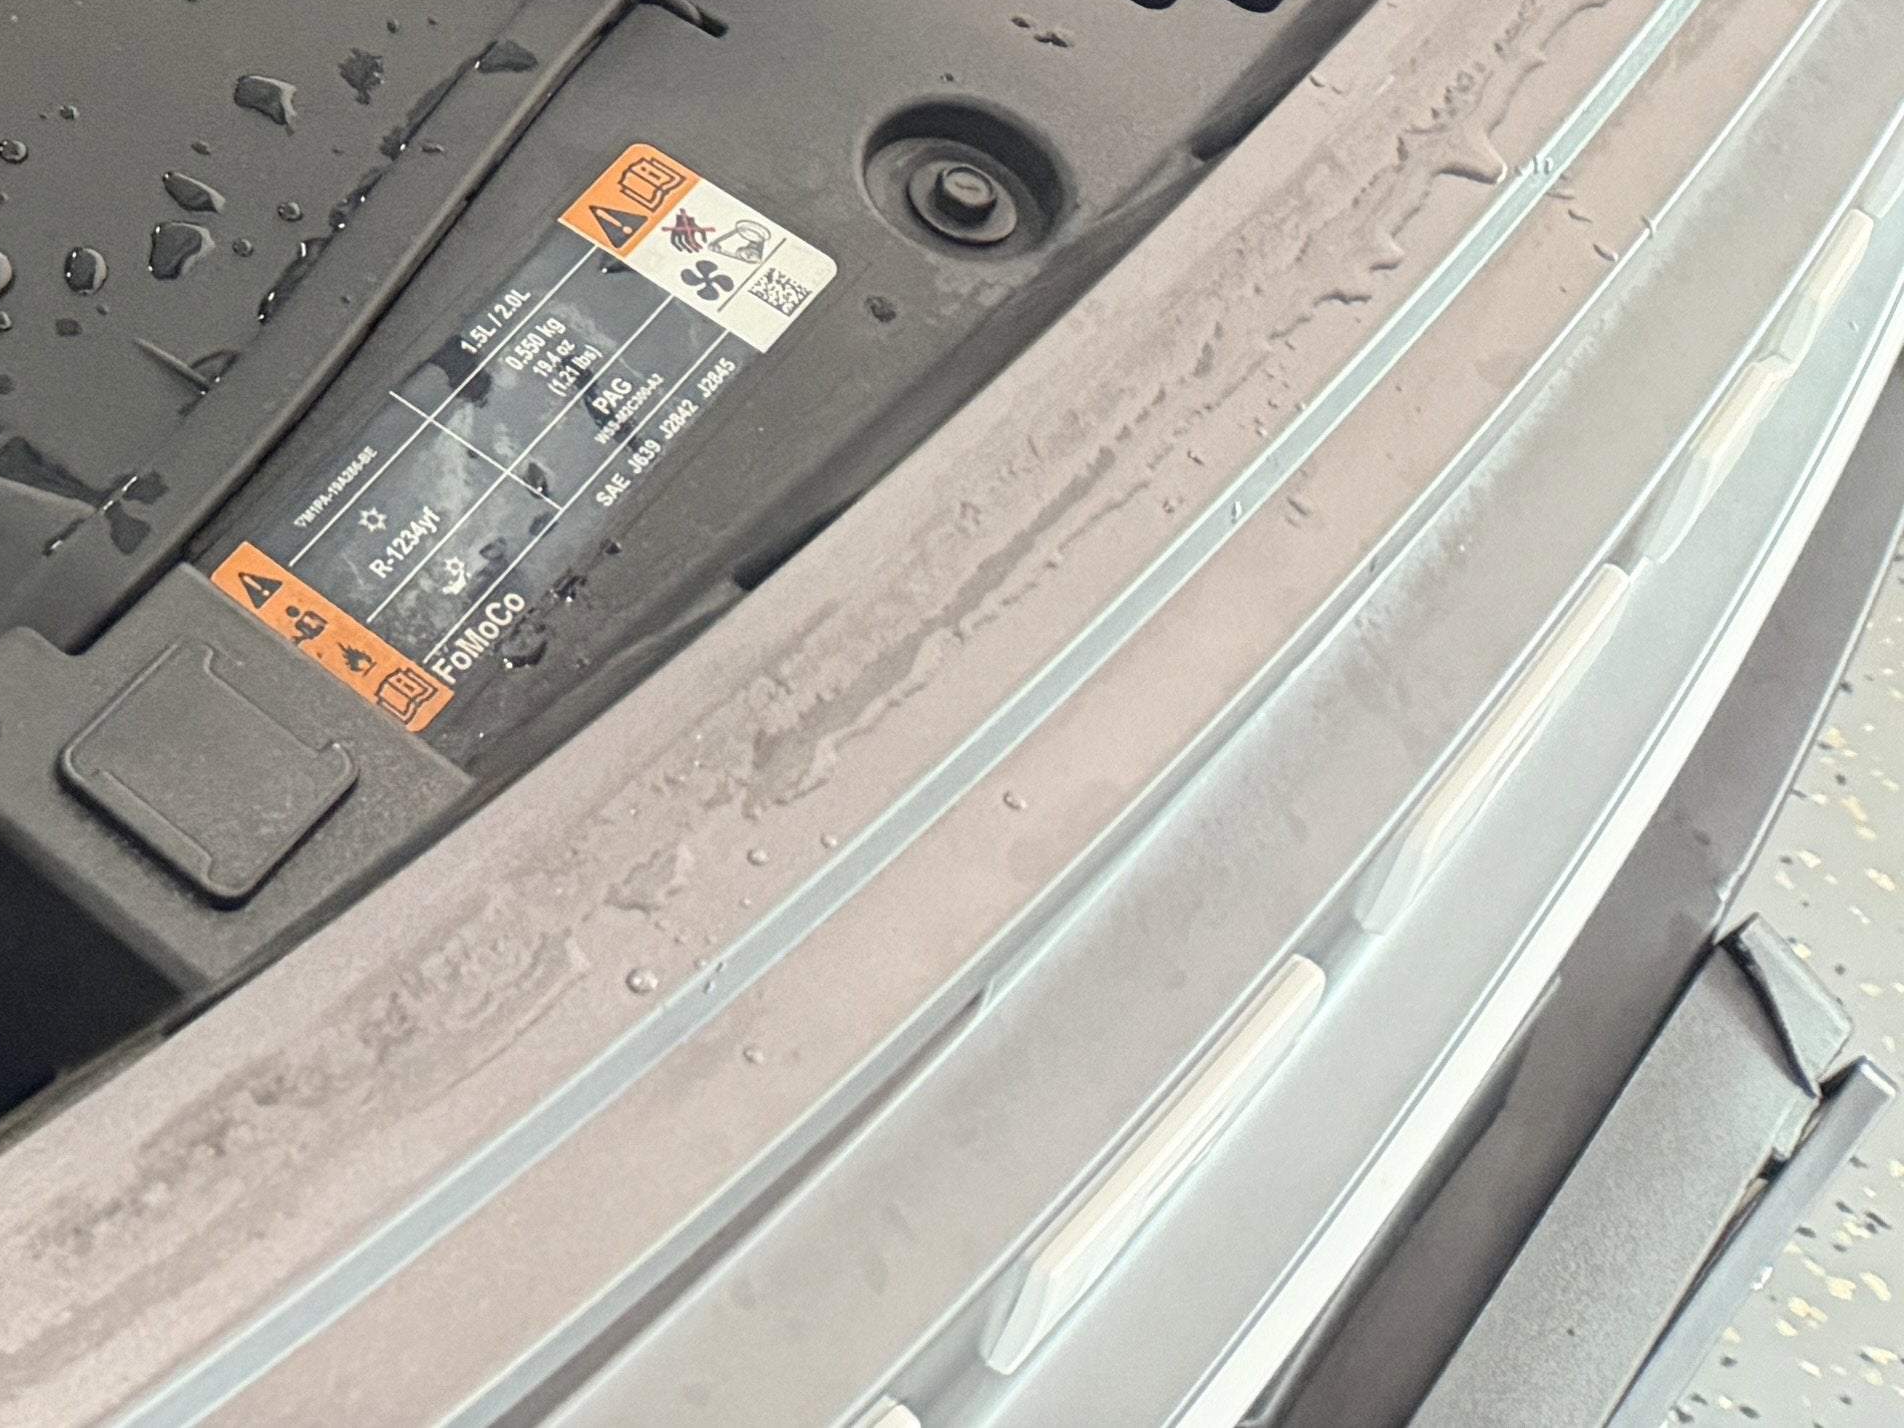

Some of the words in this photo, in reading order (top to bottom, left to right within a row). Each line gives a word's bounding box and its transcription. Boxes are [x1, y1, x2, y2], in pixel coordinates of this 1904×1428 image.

[461, 325, 496, 354] 1.5L
[494, 289, 532, 320] 2.0L
[505, 332, 546, 370] 0.550
[535, 317, 567, 339] kg
[532, 351, 562, 377] 19.4
[556, 339, 576, 356] oz
[548, 365, 581, 397] (1.21
[570, 344, 604, 370] lbs)
[592, 377, 633, 415] PAG
[596, 472, 632, 507] SAE
[627, 439, 662, 475] J639
[659, 398, 699, 440] J2842
[696, 357, 737, 399] J2845
[368, 505, 442, 580] R-1234yf
[430, 591, 526, 685] FoMoCo
